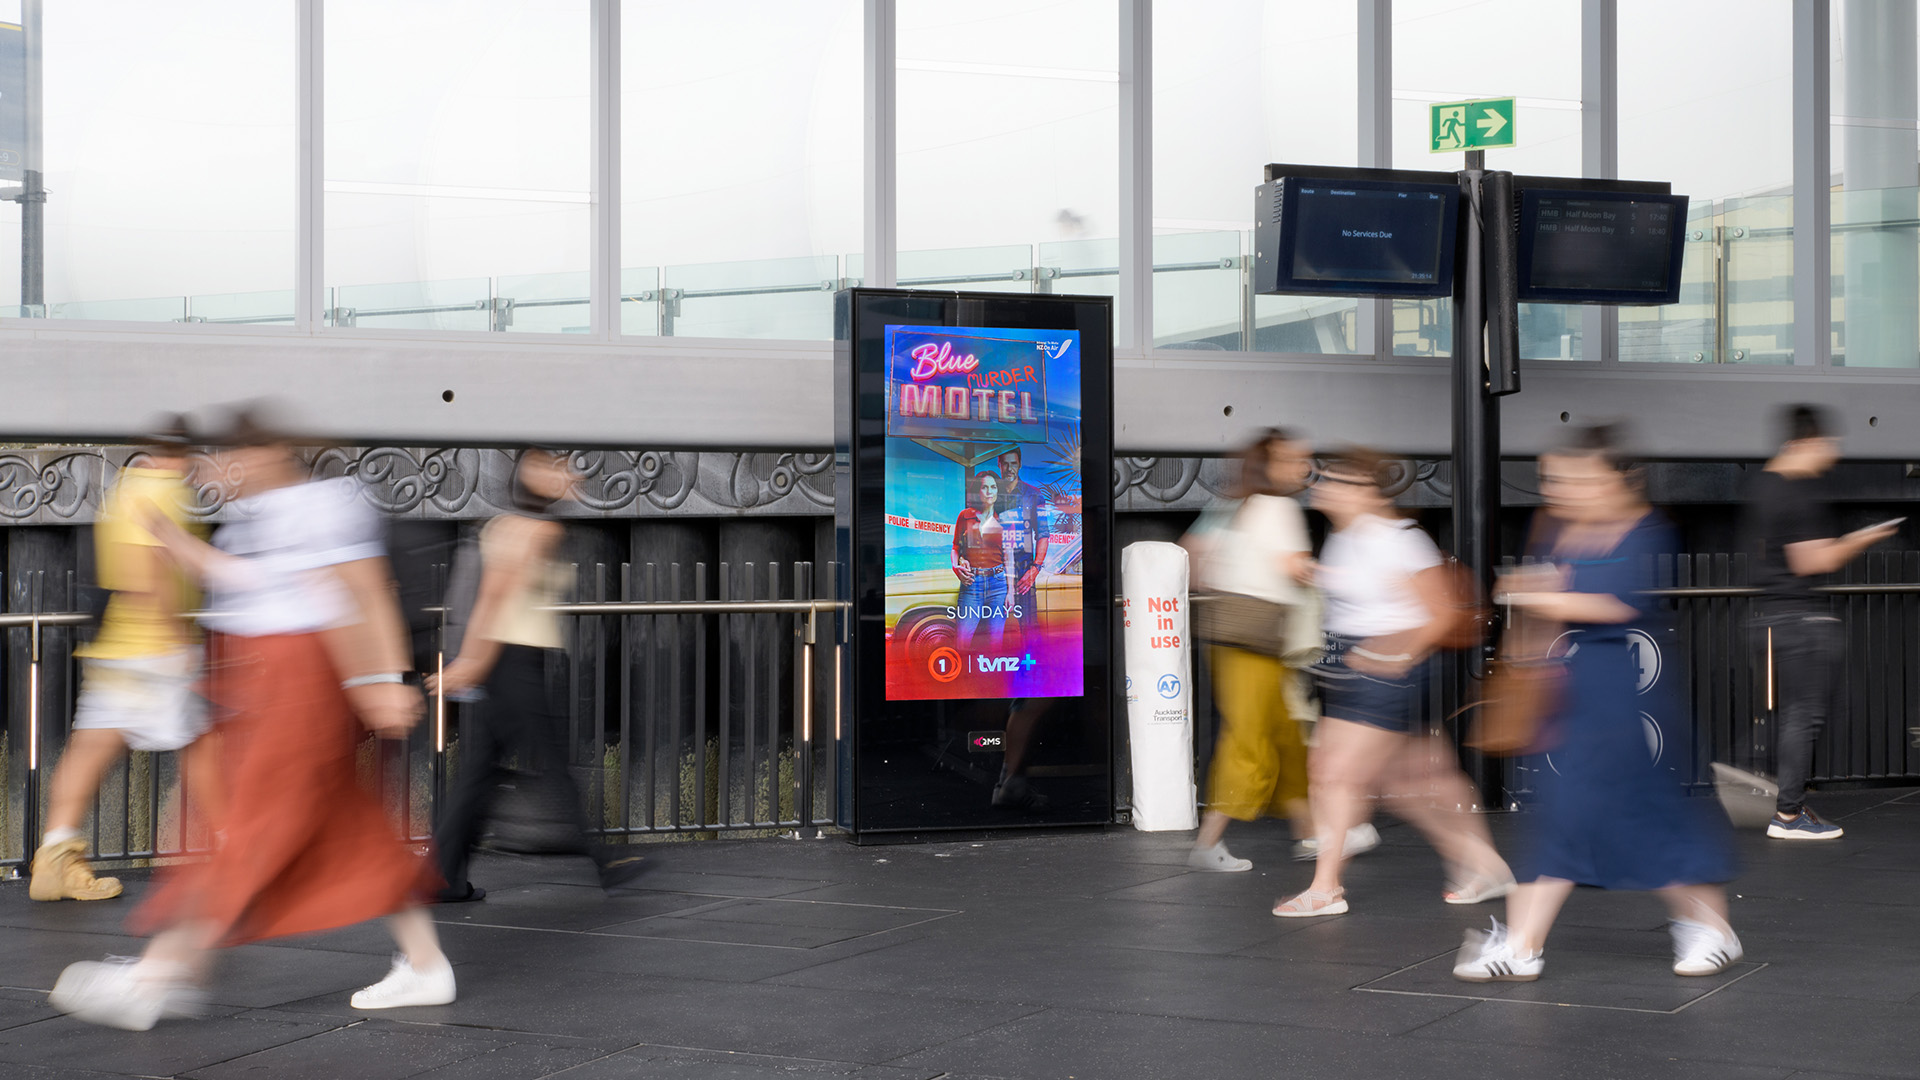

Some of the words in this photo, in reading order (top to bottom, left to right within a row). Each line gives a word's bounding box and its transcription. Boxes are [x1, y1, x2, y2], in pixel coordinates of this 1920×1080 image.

[1566, 210, 1580, 218] Half
[1582, 211, 1601, 219] Moon
[1603, 212, 1616, 221] Bay
[1649, 213, 1667, 221] 17:40
[1342, 229, 1351, 237] No
[1352, 230, 1379, 238] Services
[1379, 231, 1393, 239] Due
[1564, 224, 1579, 232] Half
[1580, 225, 1600, 233] Moon
[1602, 226, 1615, 235] Bay
[1648, 227, 1666, 235] 18:40
[911, 342, 980, 381] Blue
[967, 365, 1038, 391] MURDER
[900, 383, 1039, 425] MOTEL
[888, 515, 910, 528] POLICE
[914, 520, 952, 534] EMERGENCY
[946, 605, 1023, 620] SUNDAYS
[1148, 597, 1179, 613] Not
[1157, 614, 1174, 631] in
[1150, 635, 1181, 649] use
[938, 658, 946, 673] 1
